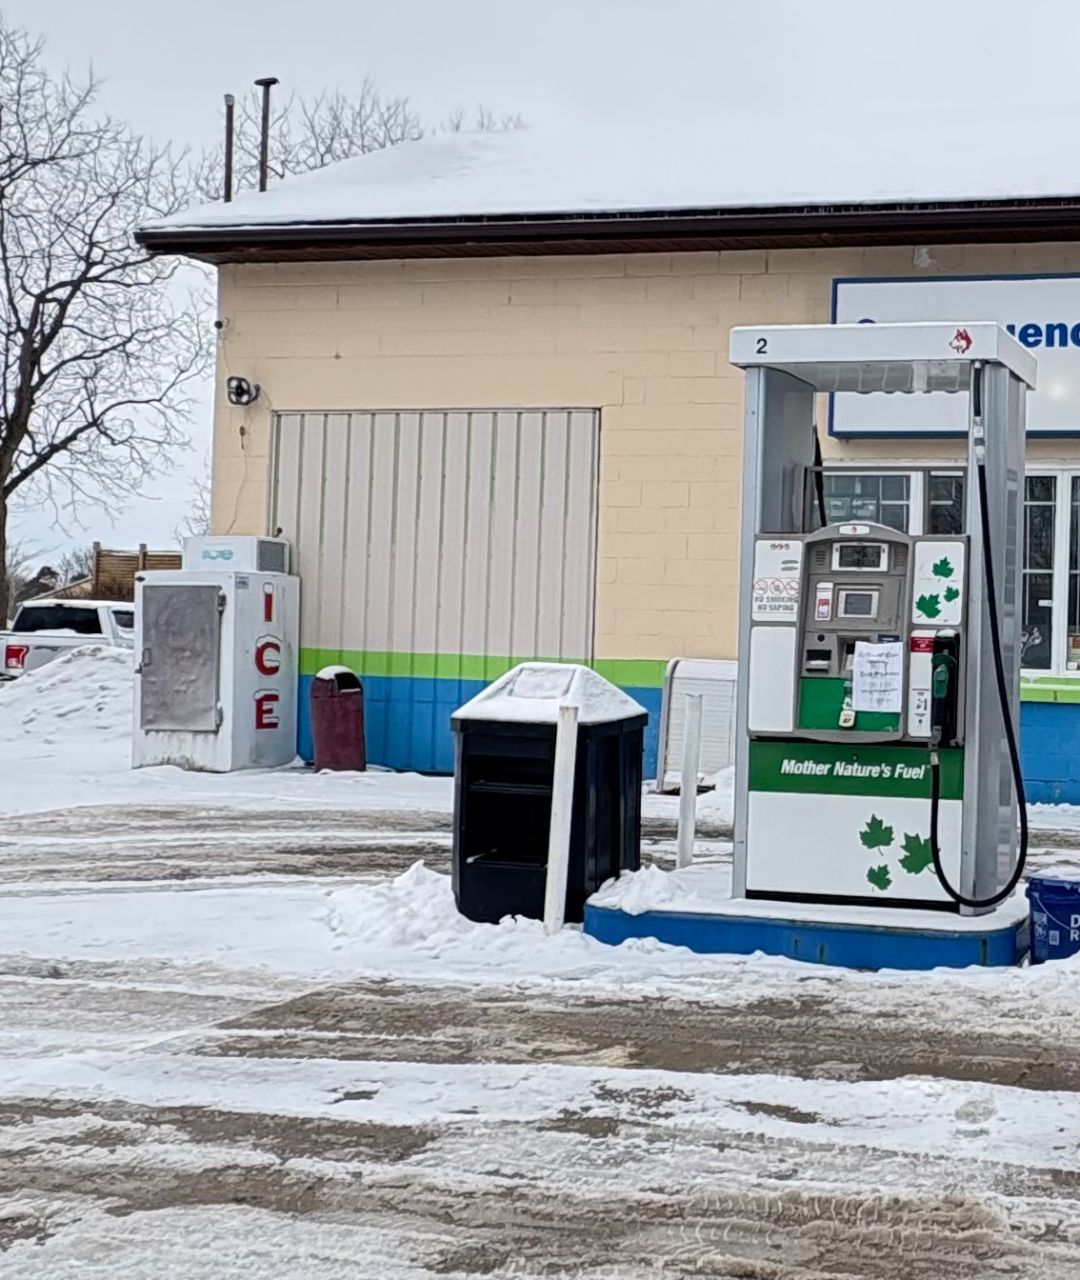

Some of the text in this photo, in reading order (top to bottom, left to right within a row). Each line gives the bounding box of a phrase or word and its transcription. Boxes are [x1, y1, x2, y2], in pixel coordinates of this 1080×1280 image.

[756, 338, 768, 354] 2
[254, 582, 282, 730] ICE
[781, 758, 926, 779] Mother Nature's Fuel
